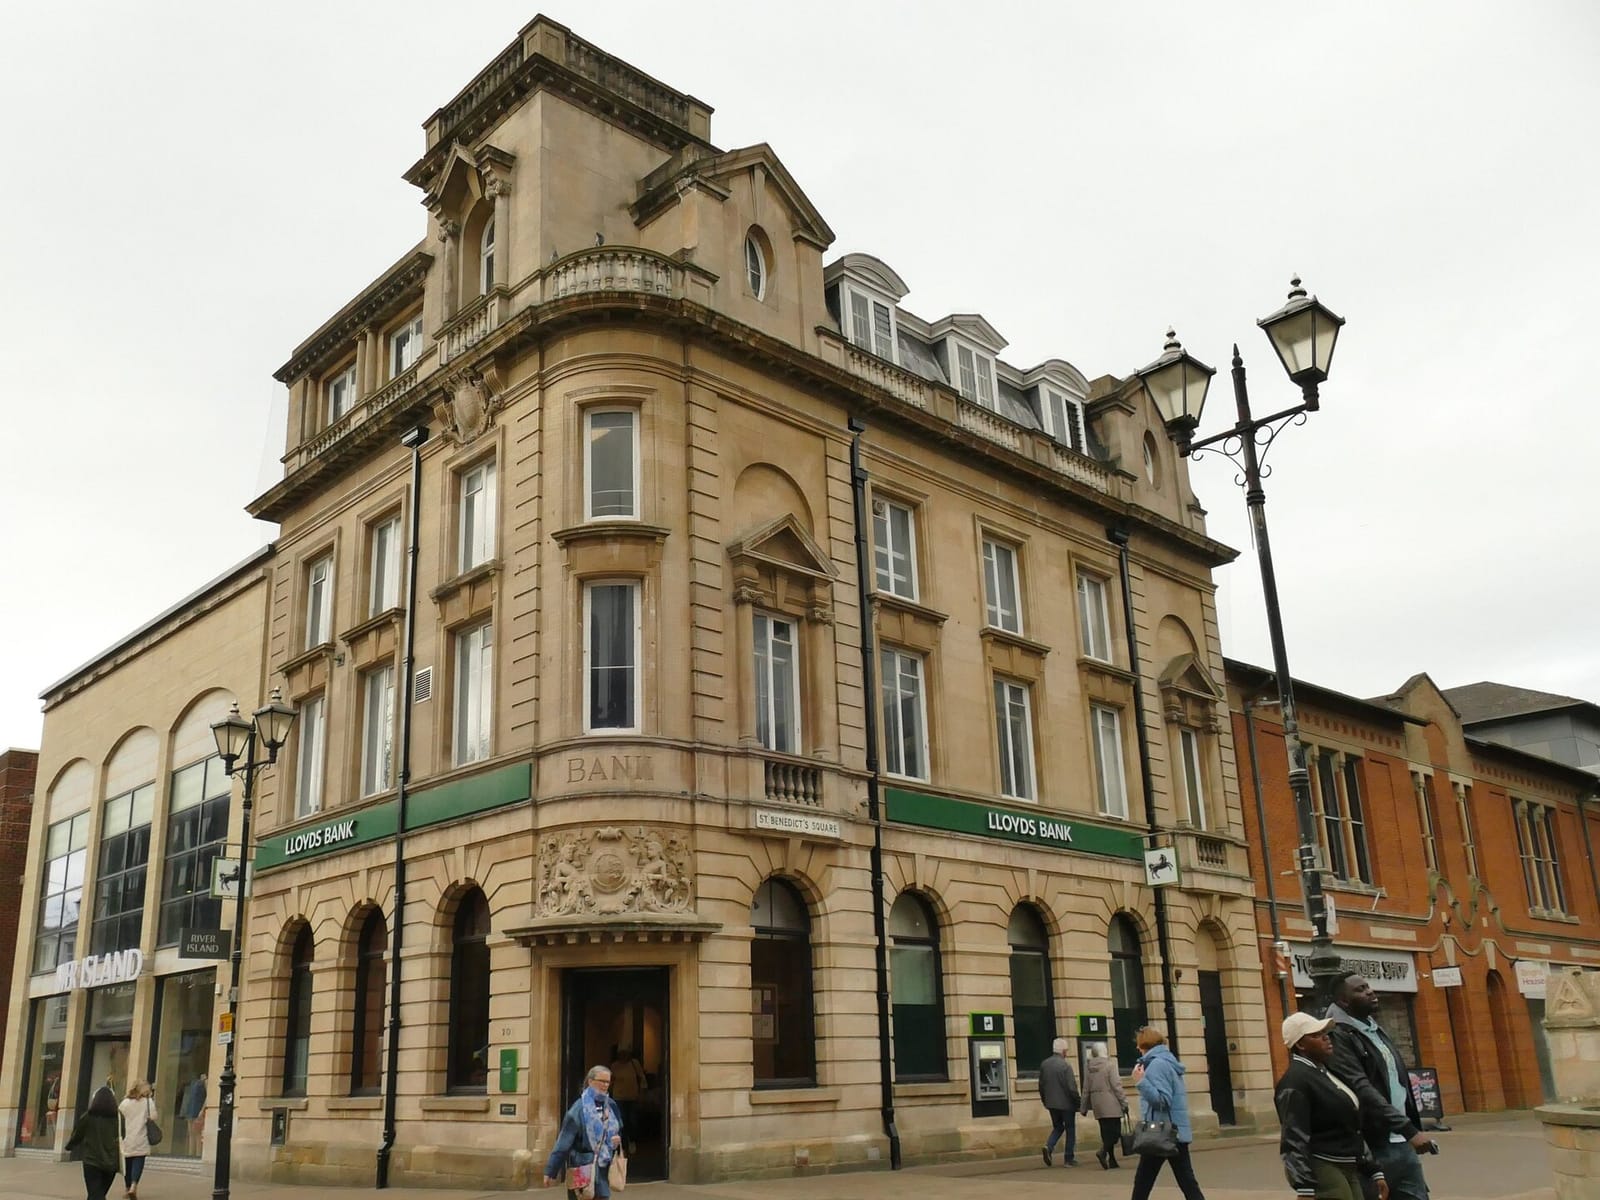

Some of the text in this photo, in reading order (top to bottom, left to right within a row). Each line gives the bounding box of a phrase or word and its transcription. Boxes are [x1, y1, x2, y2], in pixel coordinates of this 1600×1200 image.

[812, 822, 837, 833] SQUARE
[988, 811, 1073, 842] LLOYDS BANK
[285, 819, 354, 855] LLOYDS BANK
[186, 943, 219, 953] ISLAND
[190, 934, 216, 943] RIVER
[80, 948, 144, 988] ISLAND
[1382, 961, 1409, 981] SHOP
